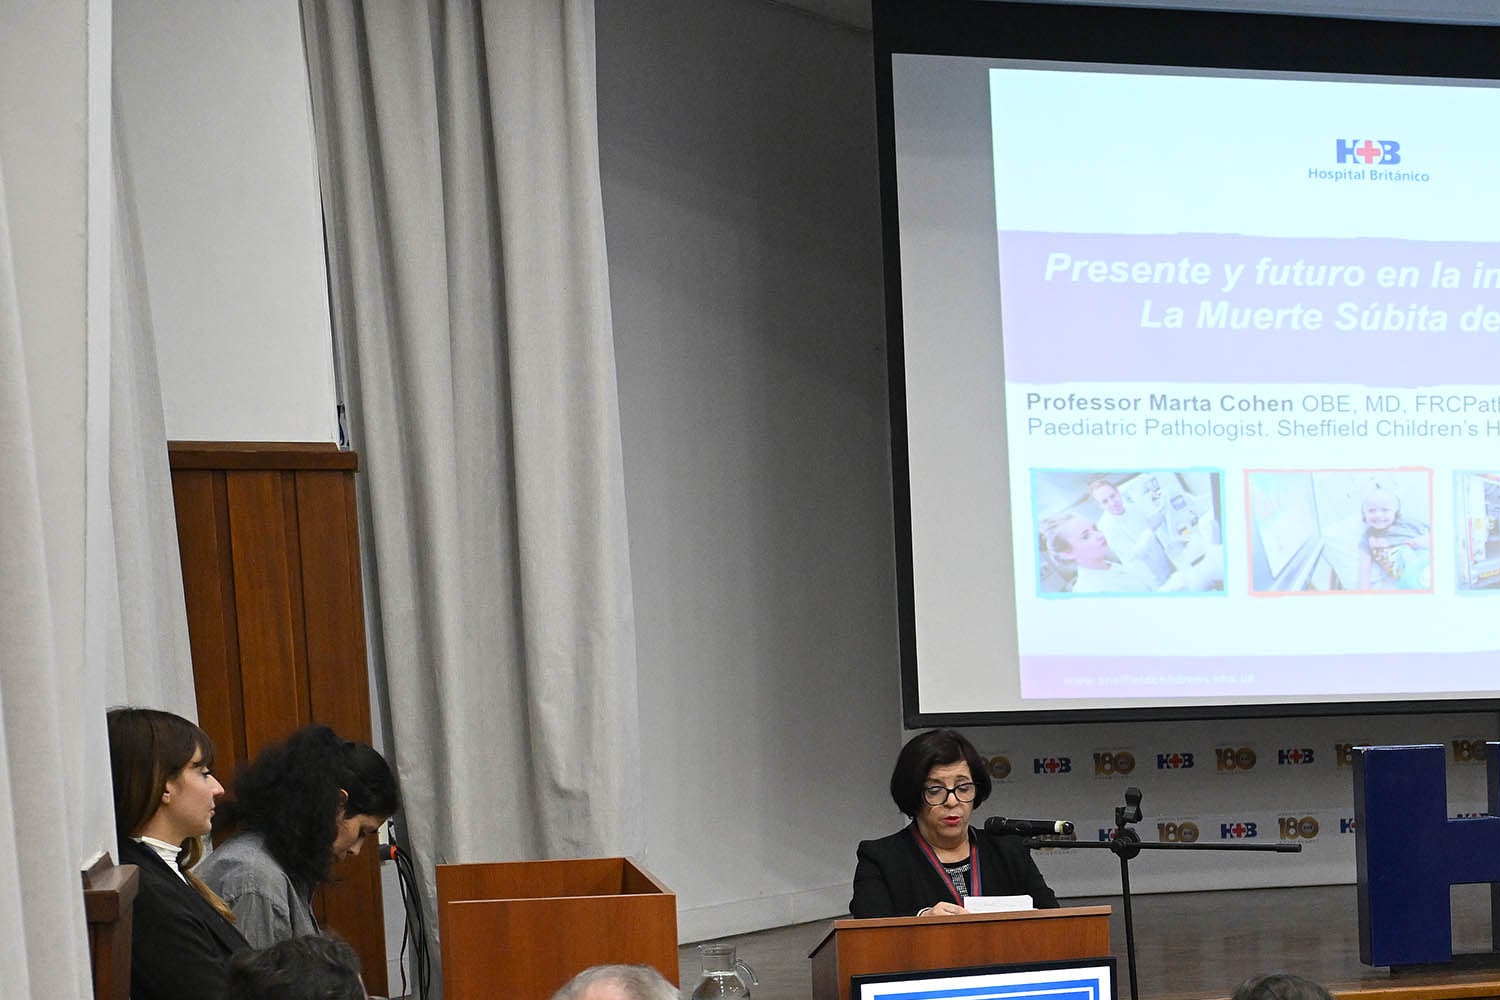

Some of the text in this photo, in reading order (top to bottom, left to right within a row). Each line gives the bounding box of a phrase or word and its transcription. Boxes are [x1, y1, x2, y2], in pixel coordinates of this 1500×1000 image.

[1308, 168, 1365, 181] Hospital
[1044, 252, 1211, 284] Presente
[1220, 263, 1245, 293] y
[1254, 257, 1366, 288] futuro
[1376, 264, 1420, 289] en
[1431, 261, 1461, 289] la
[1140, 300, 1185, 329] La
[1196, 300, 1323, 331] Muerte
[1335, 301, 1448, 332] Súbita
[1026, 393, 1141, 412] Professor
[1149, 393, 1212, 412] Marta
[1220, 394, 1294, 413] Cohen
[1302, 395, 1358, 415] OBE,
[1366, 395, 1406, 416] MD,
[1028, 417, 1137, 437] Paediatric
[1278, 419, 1369, 438] Sheffield
[1376, 420, 1479, 438] Children's
[1093, 751, 1135, 775] 180
[1215, 747, 1256, 772] 180
[1157, 822, 1199, 842] 180
[1278, 816, 1319, 840] 180
